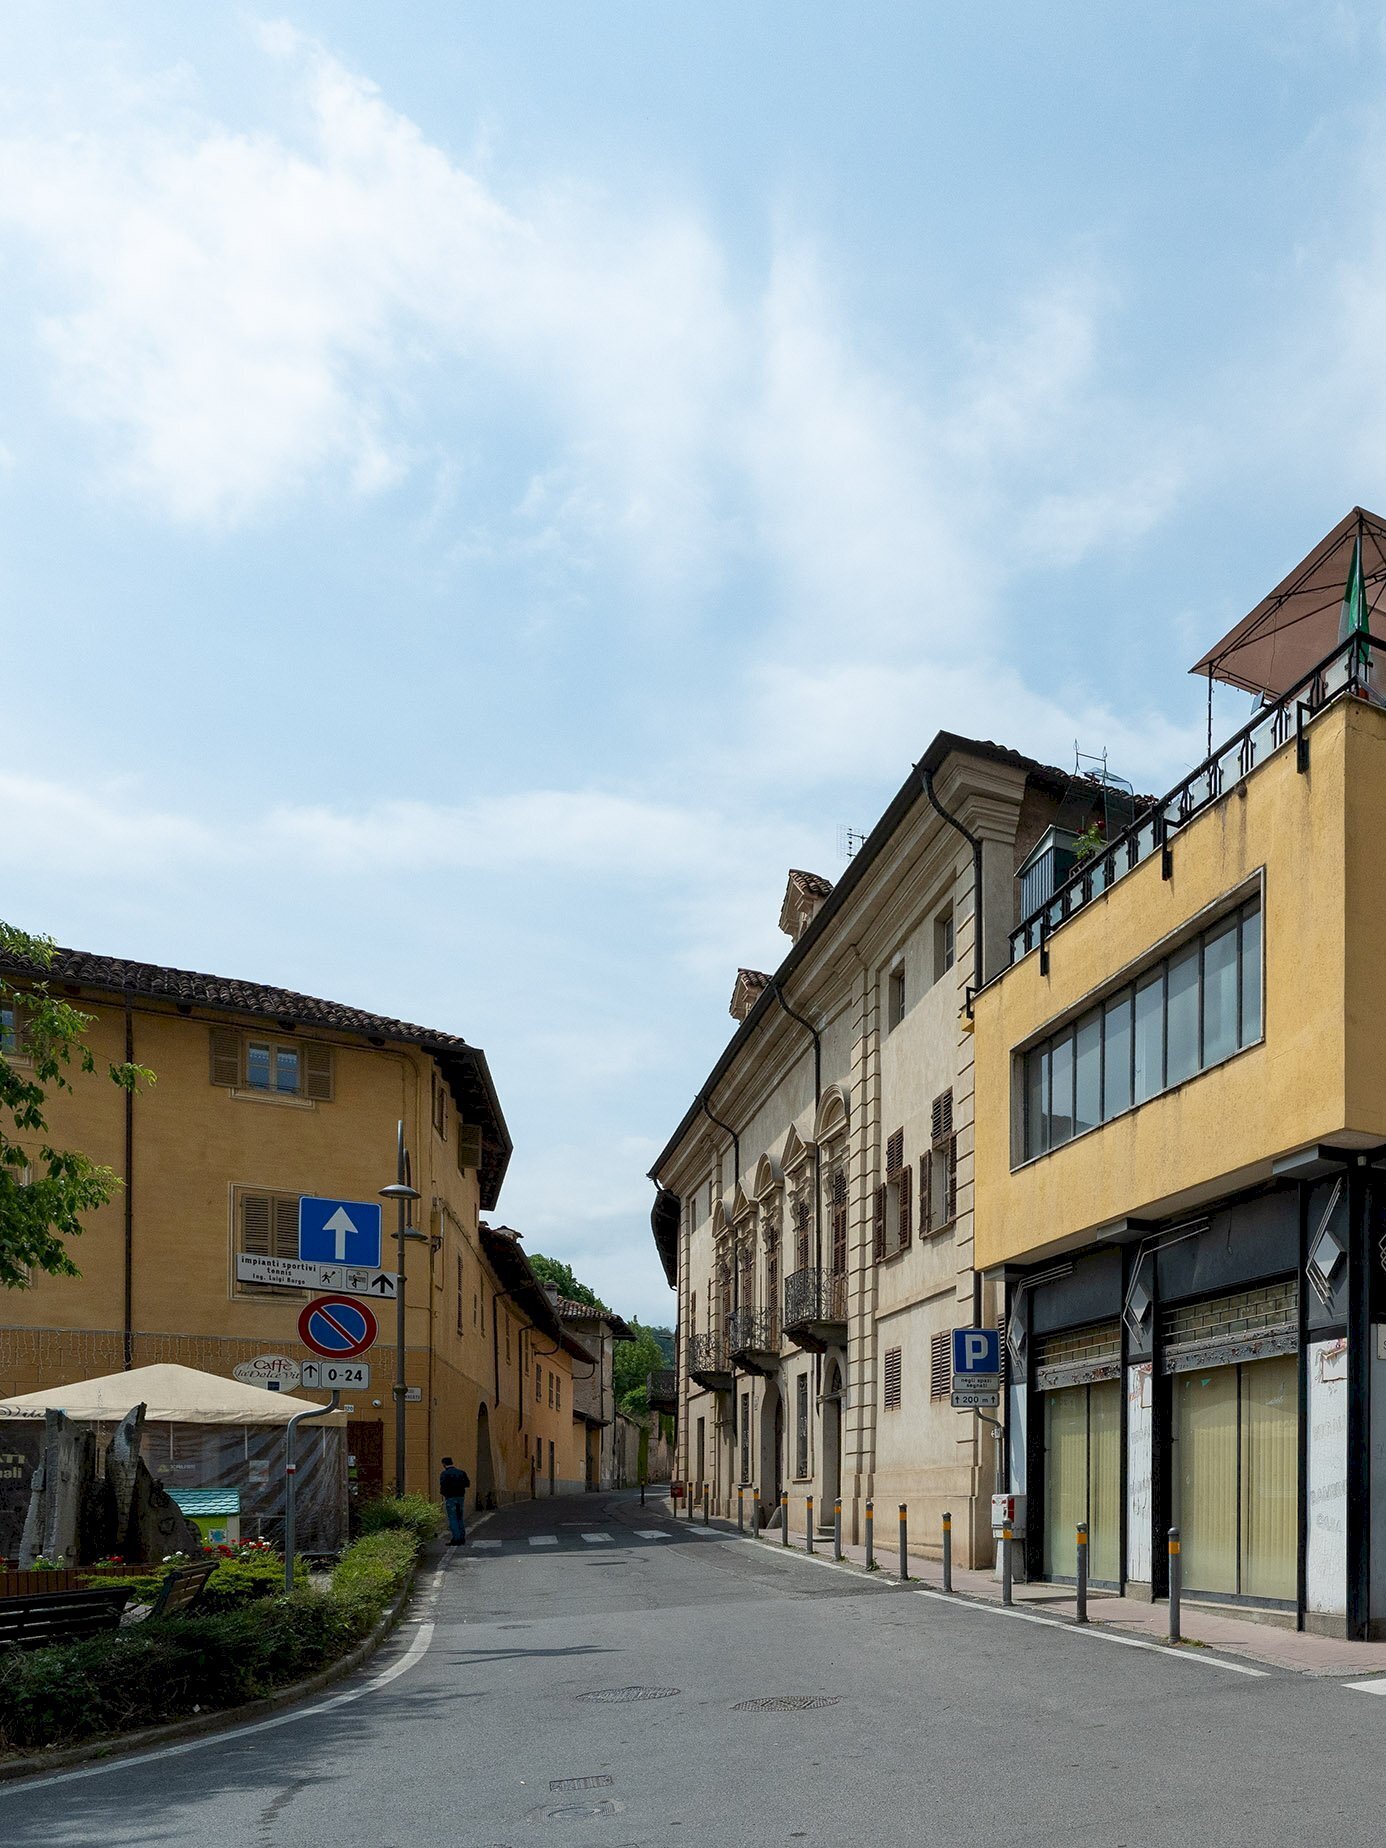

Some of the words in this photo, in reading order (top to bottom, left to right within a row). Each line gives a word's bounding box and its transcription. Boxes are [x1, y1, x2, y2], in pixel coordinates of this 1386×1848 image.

[241, 1256, 280, 1268] impianti
[282, 1263, 317, 1272] sportivi
[267, 1267, 292, 1277] tennis
[965, 1334, 988, 1370] P
[253, 1359, 293, 1373] Caffè
[328, 1369, 363, 1382] 0-24
[963, 1396, 979, 1404] 200
